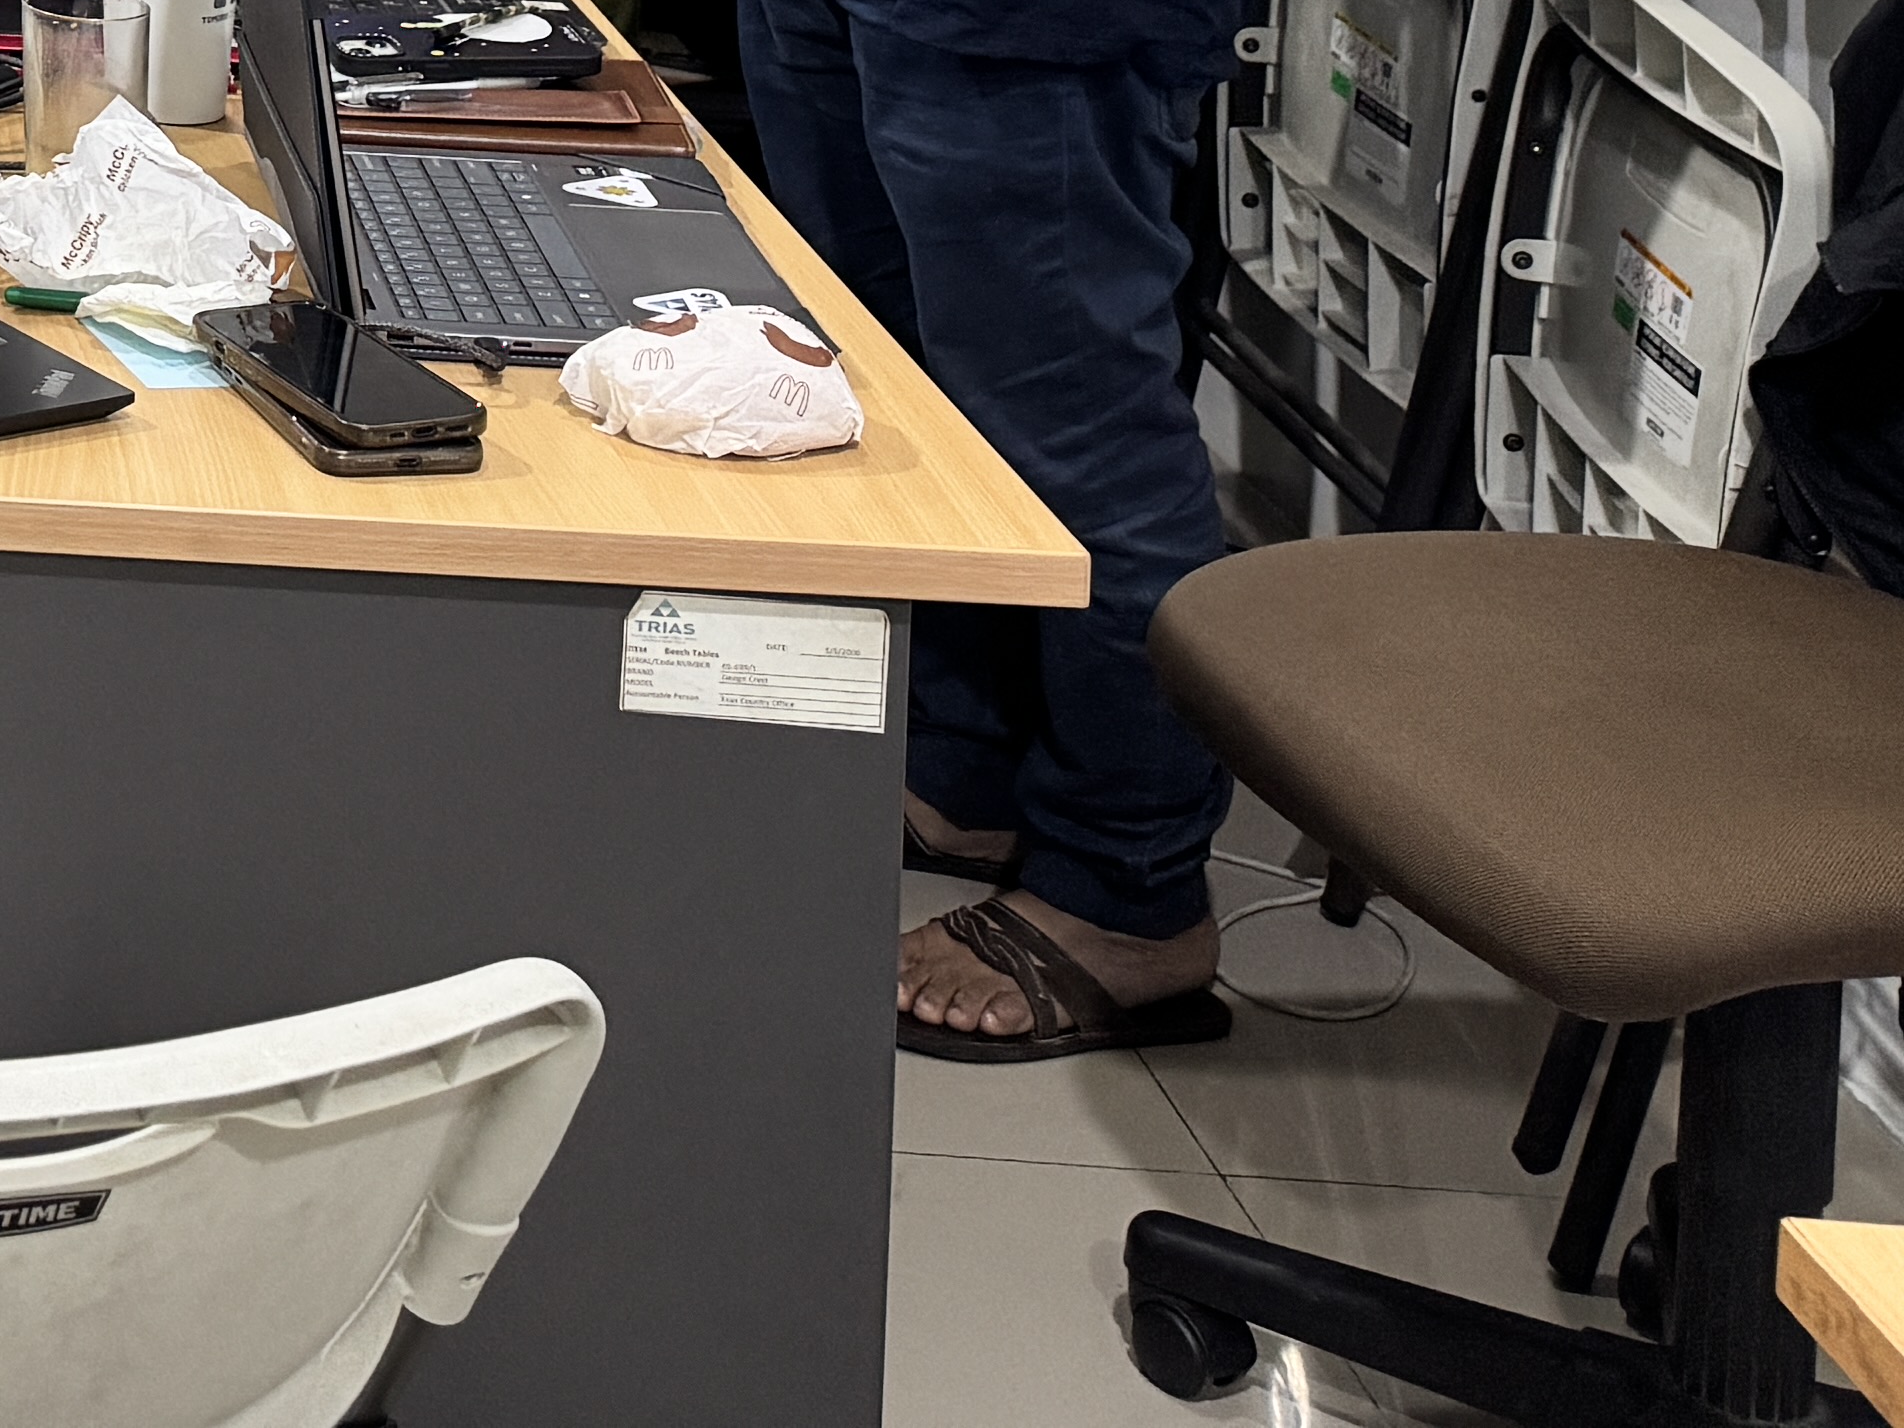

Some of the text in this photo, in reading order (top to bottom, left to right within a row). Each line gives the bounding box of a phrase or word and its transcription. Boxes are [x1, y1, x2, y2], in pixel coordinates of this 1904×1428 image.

[634, 619, 696, 635] TRIAS
[673, 693, 699, 701] Person
[740, 696, 769, 707] Country
